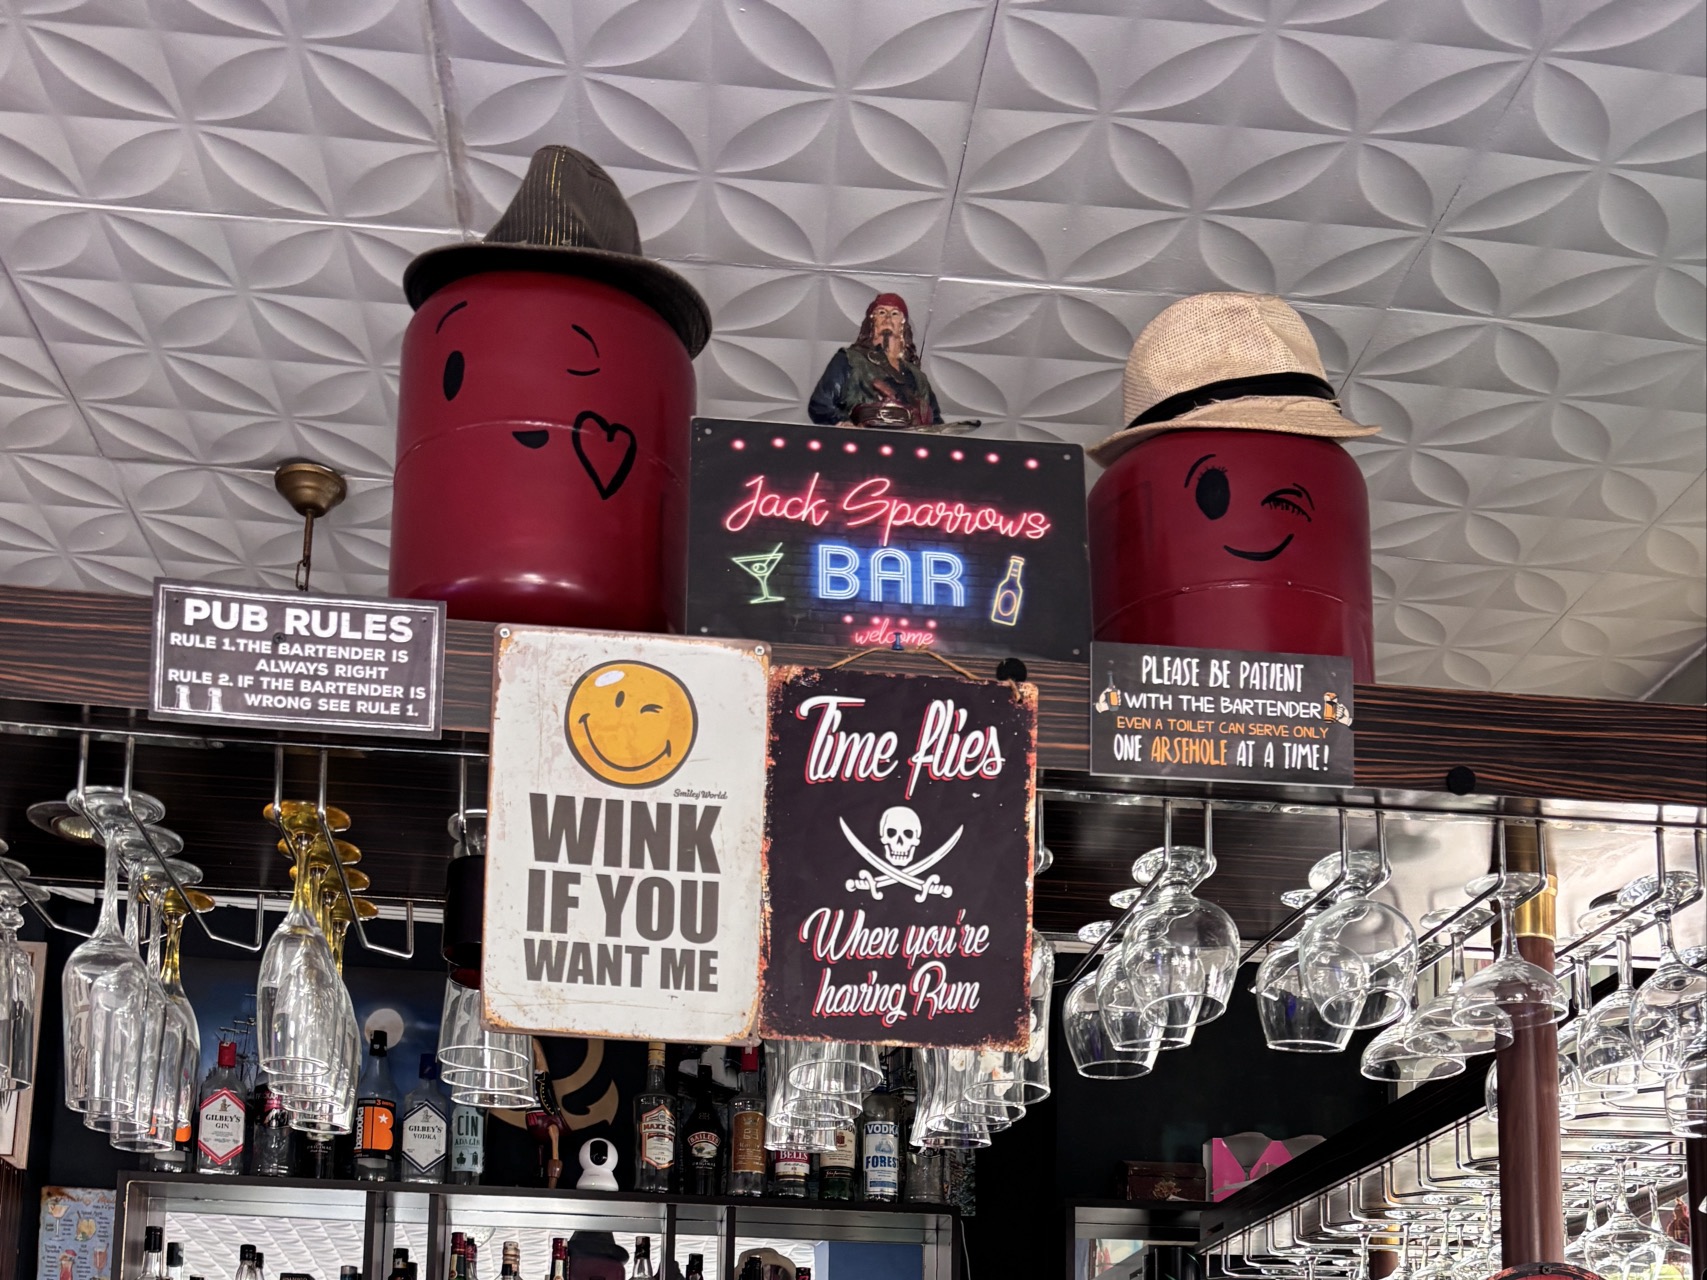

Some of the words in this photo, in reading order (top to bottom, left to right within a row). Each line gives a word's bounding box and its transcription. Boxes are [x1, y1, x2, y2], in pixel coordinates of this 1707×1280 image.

[725, 472, 829, 532] Jack
[842, 478, 1051, 546] Sparrows
[818, 544, 965, 607] BAR
[184, 598, 268, 632] PUB
[284, 607, 413, 643] RULES
[855, 618, 935, 646] welcome
[170, 633, 216, 649] RULE
[279, 642, 386, 662] BARTENDER
[391, 650, 409, 663] IS
[168, 669, 213, 685] RULE
[217, 674, 233, 686] 2.
[237, 675, 254, 688] IF
[260, 677, 294, 691] THE
[300, 680, 404, 698] BARTENDER
[410, 686, 426, 700] IS
[255, 659, 329, 676] ALWAYS
[335, 664, 389, 680] RIGHT
[1142, 655, 1200, 687] PLEASE
[1209, 660, 1231, 688] BE
[1239, 661, 1304, 692] PATIENT
[244, 693, 312, 710] WRONG
[318, 698, 350, 712] SEE
[356, 701, 400, 716] RULE
[406, 705, 419, 717] 1.
[1124, 692, 1172, 711] WITH
[1179, 695, 1215, 713] THE
[1220, 697, 1322, 719] BARTENDER
[1117, 716, 1151, 730] EVEN
[1154, 718, 1163, 730] A
[1167, 719, 1215, 733] TOILET
[1219, 722, 1245, 735] CAN
[1248, 724, 1289, 737] SERVE
[1293, 726, 1329, 739] ONLY
[798, 696, 898, 783] Time
[906, 699, 1005, 799] flies
[1113, 733, 1142, 762] ONE
[1151, 736, 1228, 766] ARSEHOLE
[1237, 740, 1256, 768] AT
[1264, 741, 1274, 768] A
[1283, 742, 1330, 771] TIME!
[529, 793, 722, 874] WINK
[527, 868, 580, 934] IF
[596, 873, 720, 944] YOU
[801, 907, 899, 963] When
[903, 908, 989, 967] you're
[523, 938, 650, 988] WANT
[659, 947, 719, 993] ME
[813, 970, 906, 1025] having
[908, 960, 980, 1019] Rum
[205, 1114, 241, 1123] GILBEY'S
[408, 1125, 443, 1133] GILBEY'S
[690, 1132, 719, 1144] BAILEYS
